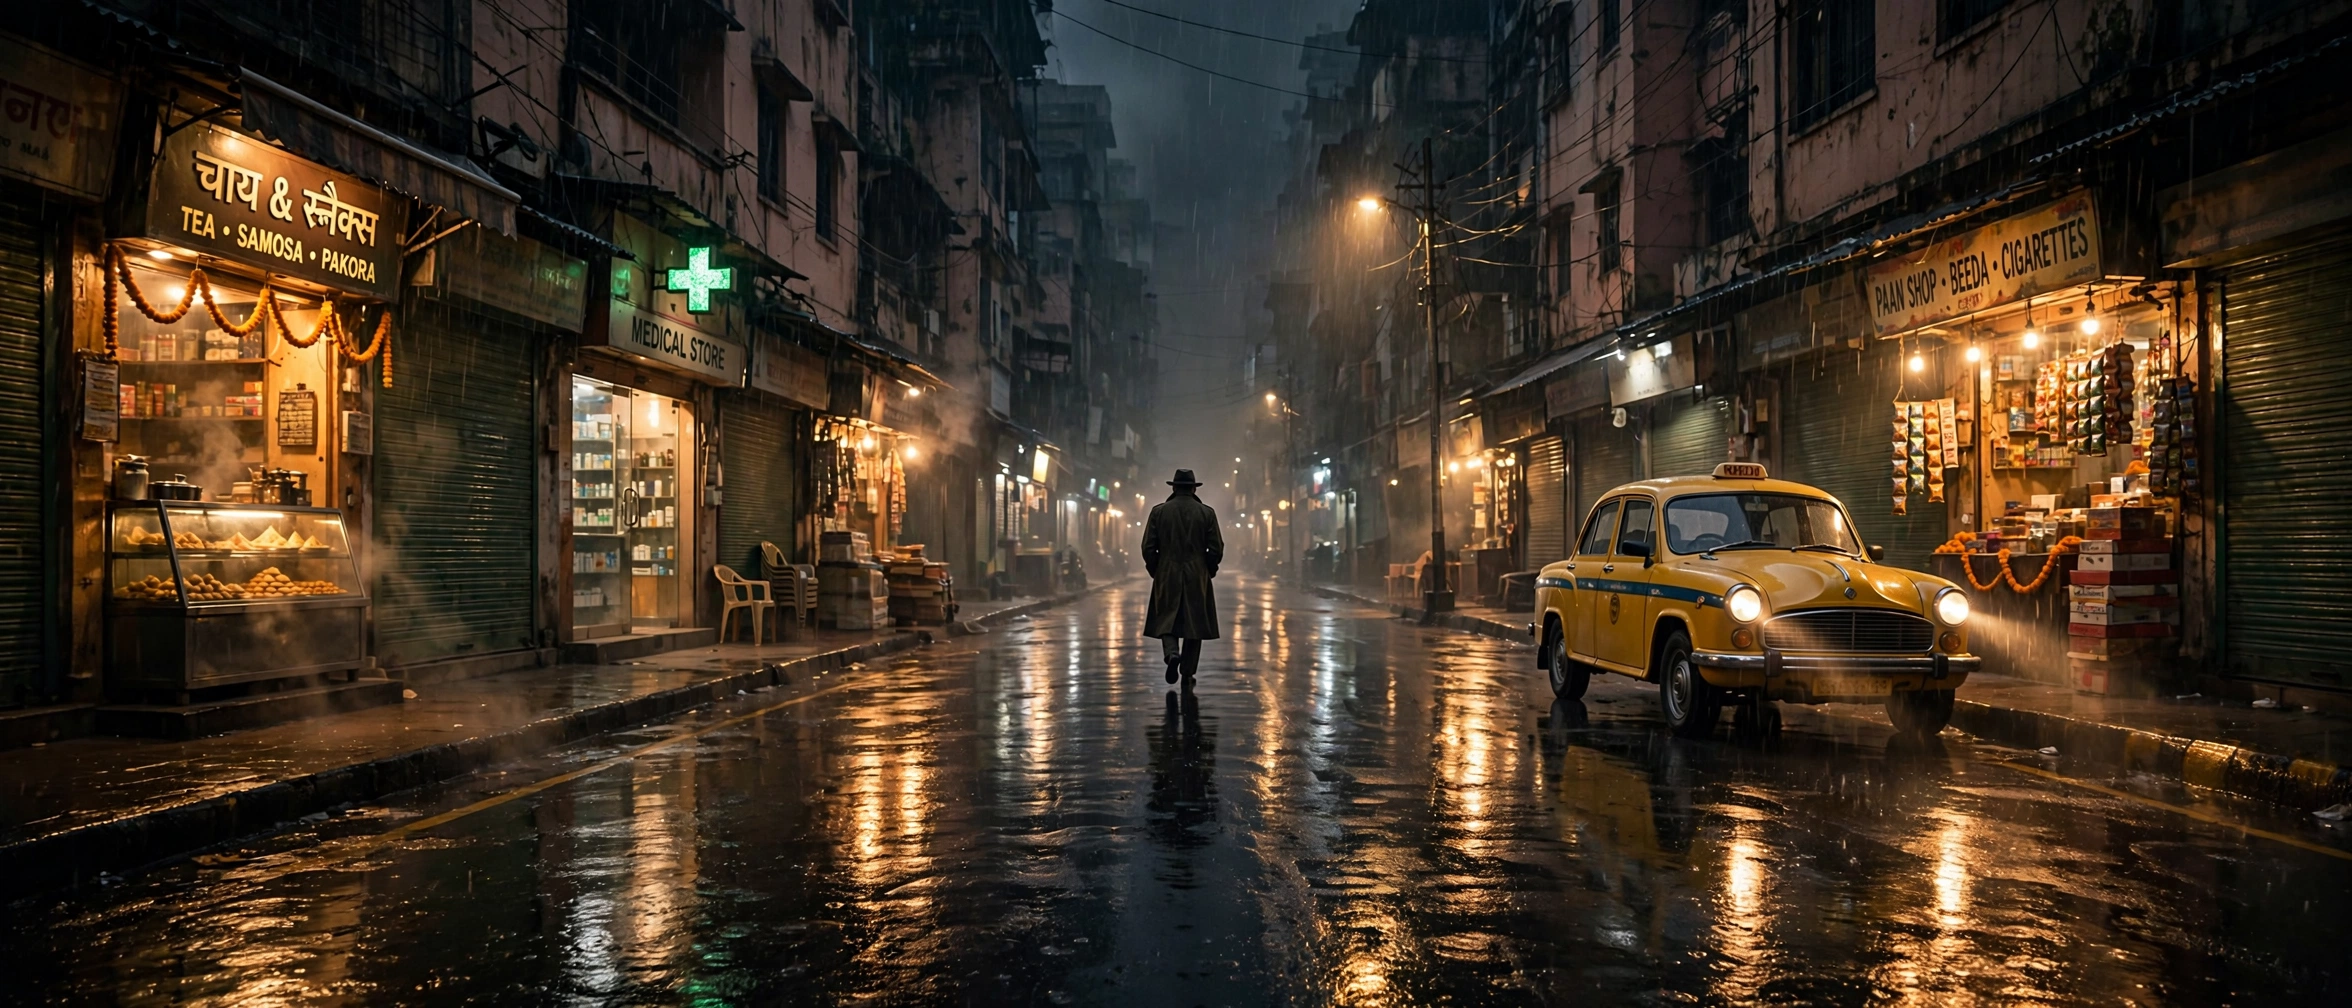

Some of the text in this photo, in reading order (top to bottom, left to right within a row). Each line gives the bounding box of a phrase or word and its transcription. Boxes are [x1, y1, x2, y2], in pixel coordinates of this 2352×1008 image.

[196, 151, 379, 247] चाय & स्नैक्स
[181, 205, 375, 283] TEA SAMOSA PAKORA
[1875, 216, 2088, 318] PAAN SHOP BEEDA CIGARETTES
[631, 315, 725, 370] MEDICAL STORE
